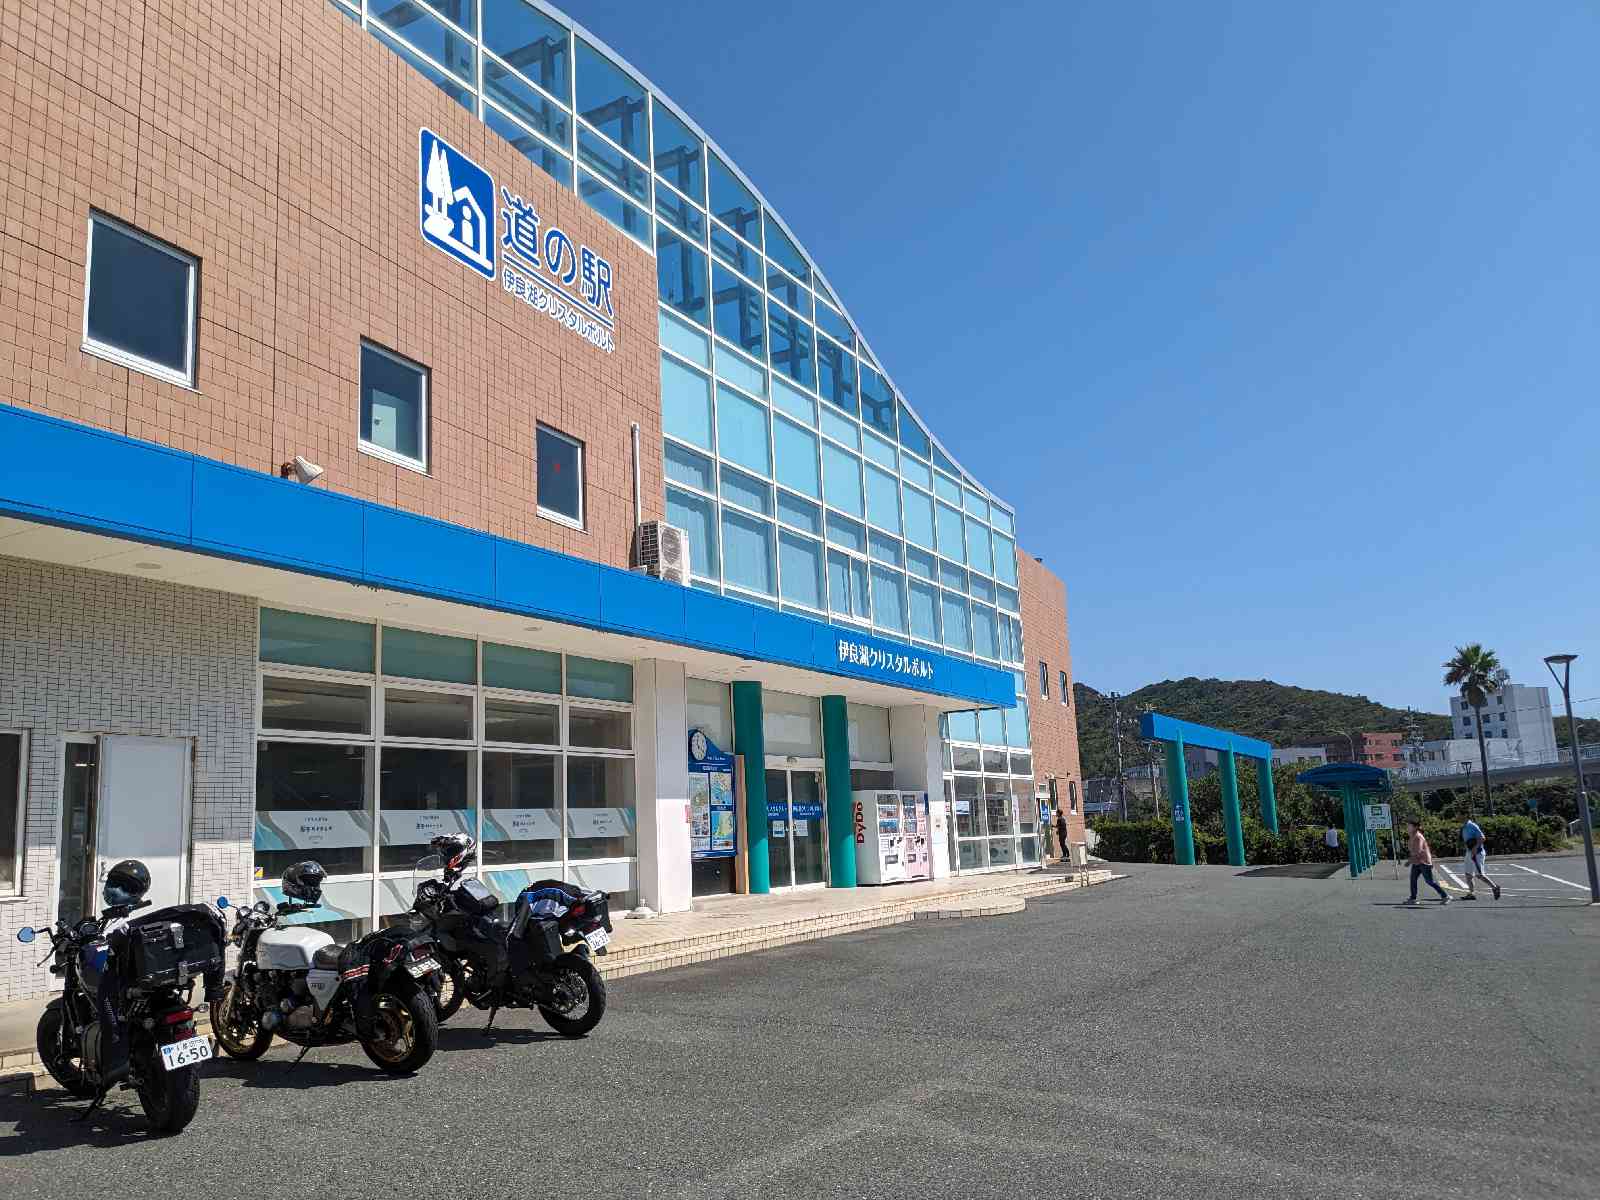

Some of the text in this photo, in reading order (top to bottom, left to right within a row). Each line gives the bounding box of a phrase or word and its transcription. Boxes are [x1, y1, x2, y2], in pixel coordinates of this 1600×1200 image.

[501, 187, 614, 317] 道の駅
[502, 265, 615, 352] 伊良湖クリスタルポルト
[838, 639, 934, 680] 伊良湖クリスタルポルト
